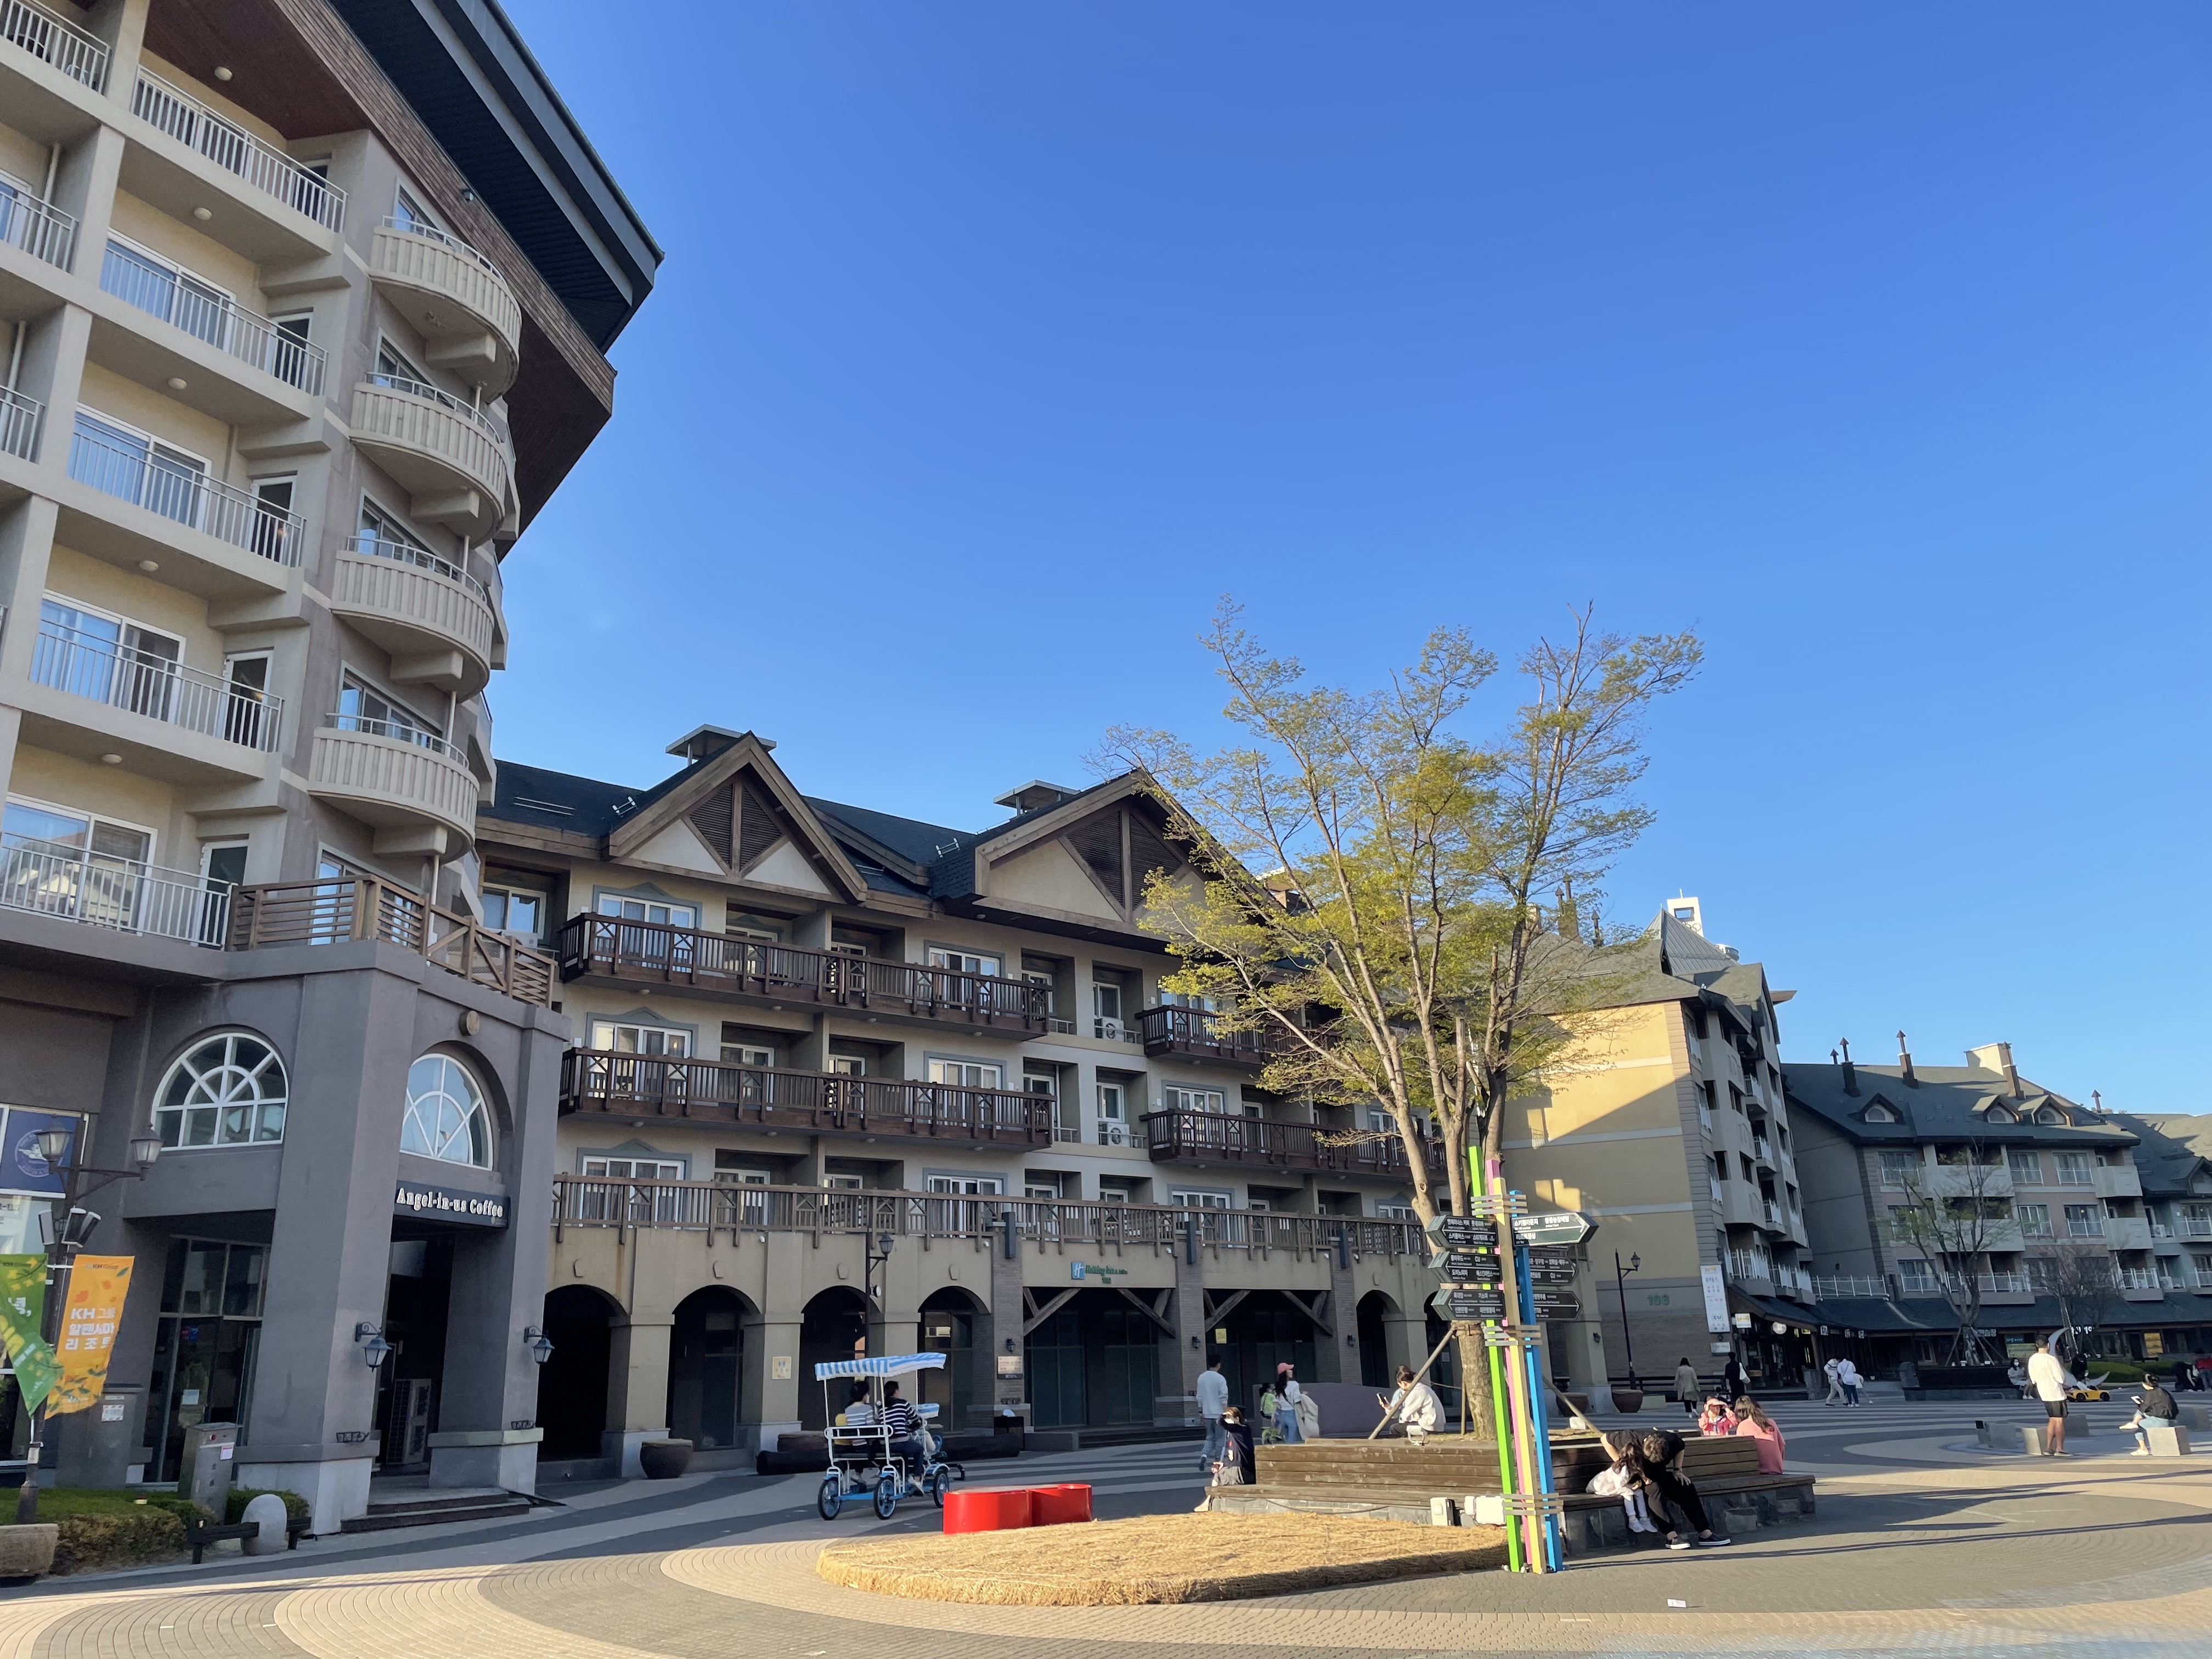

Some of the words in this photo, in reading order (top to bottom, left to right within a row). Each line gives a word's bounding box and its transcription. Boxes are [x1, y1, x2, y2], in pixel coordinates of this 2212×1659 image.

[396, 1187, 467, 1212] Angel-in-us
[470, 1199, 503, 1217] Coffee
[1647, 1294, 1670, 1306] 103
[71, 1307, 95, 1319] KH
[97, 1307, 116, 1319] 그룹
